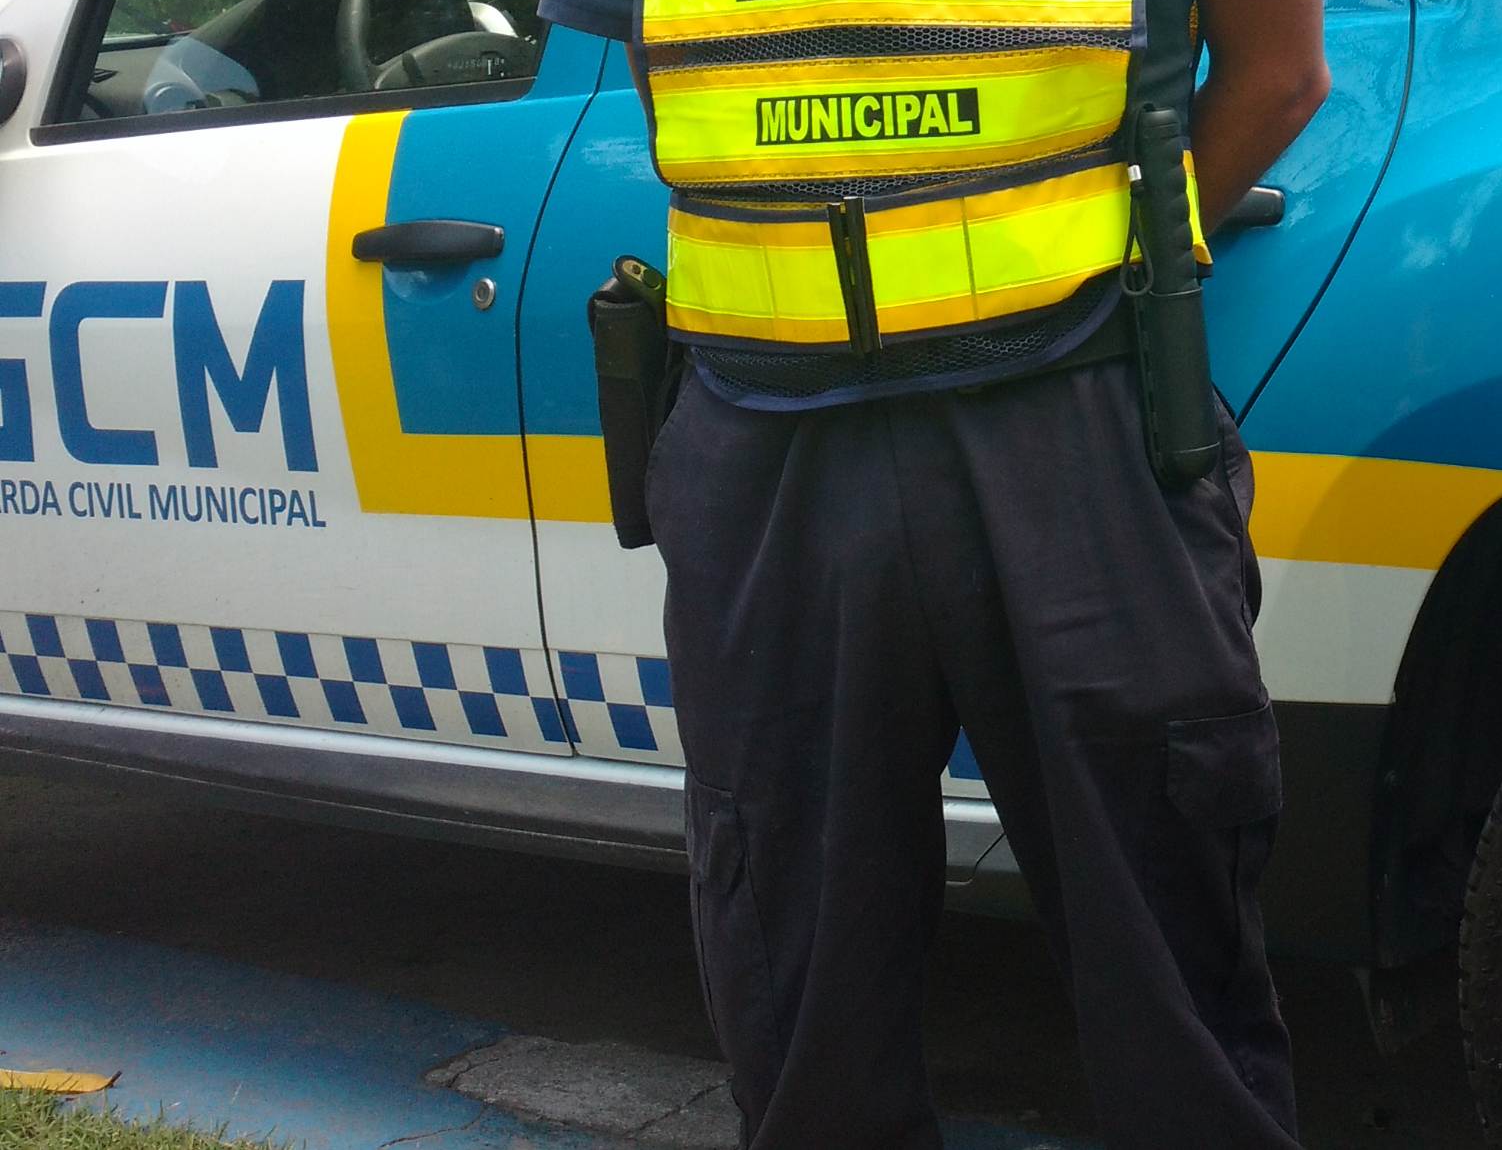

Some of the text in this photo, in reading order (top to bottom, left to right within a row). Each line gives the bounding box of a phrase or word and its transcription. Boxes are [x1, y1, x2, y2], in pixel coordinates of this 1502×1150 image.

[761, 92, 974, 142] MUNICIPAL
[0, 479, 327, 529] RDA CIVIL MUNICIPAL
